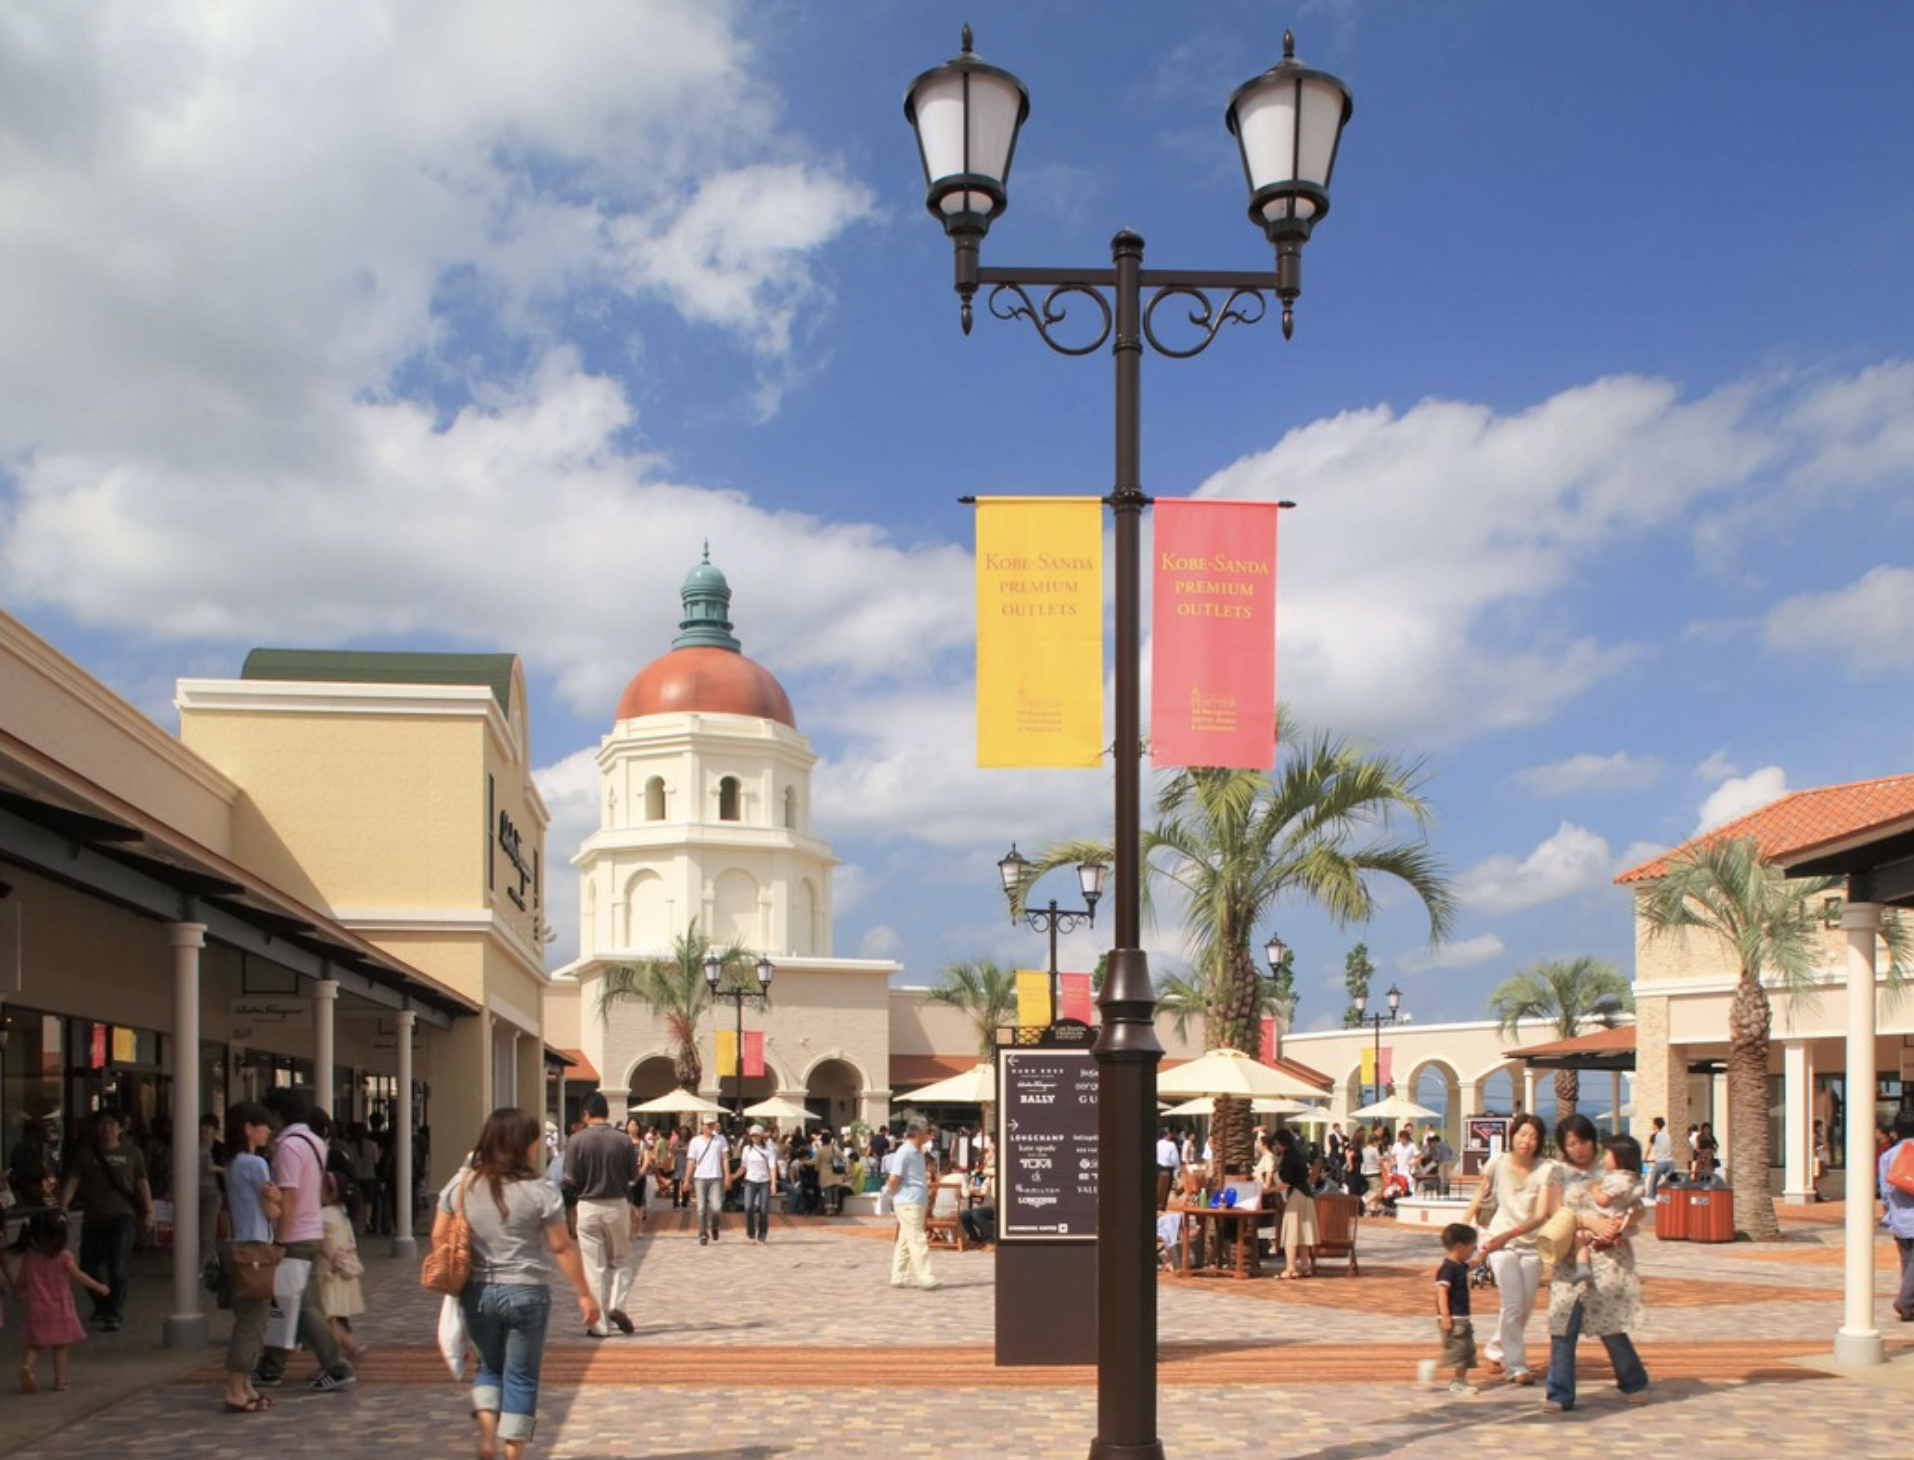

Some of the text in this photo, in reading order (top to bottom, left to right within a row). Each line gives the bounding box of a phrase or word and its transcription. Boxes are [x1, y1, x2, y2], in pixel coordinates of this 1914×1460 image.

[1000, 581, 1078, 593] PREMIUM
[1176, 580, 1254, 597] PREMIUM
[1001, 603, 1077, 617] OUTLETS
[1177, 603, 1253, 619] OUTLETS
[1020, 1095, 1055, 1104] BALLY
[1009, 1134, 1064, 1142] LONGCHAMP
